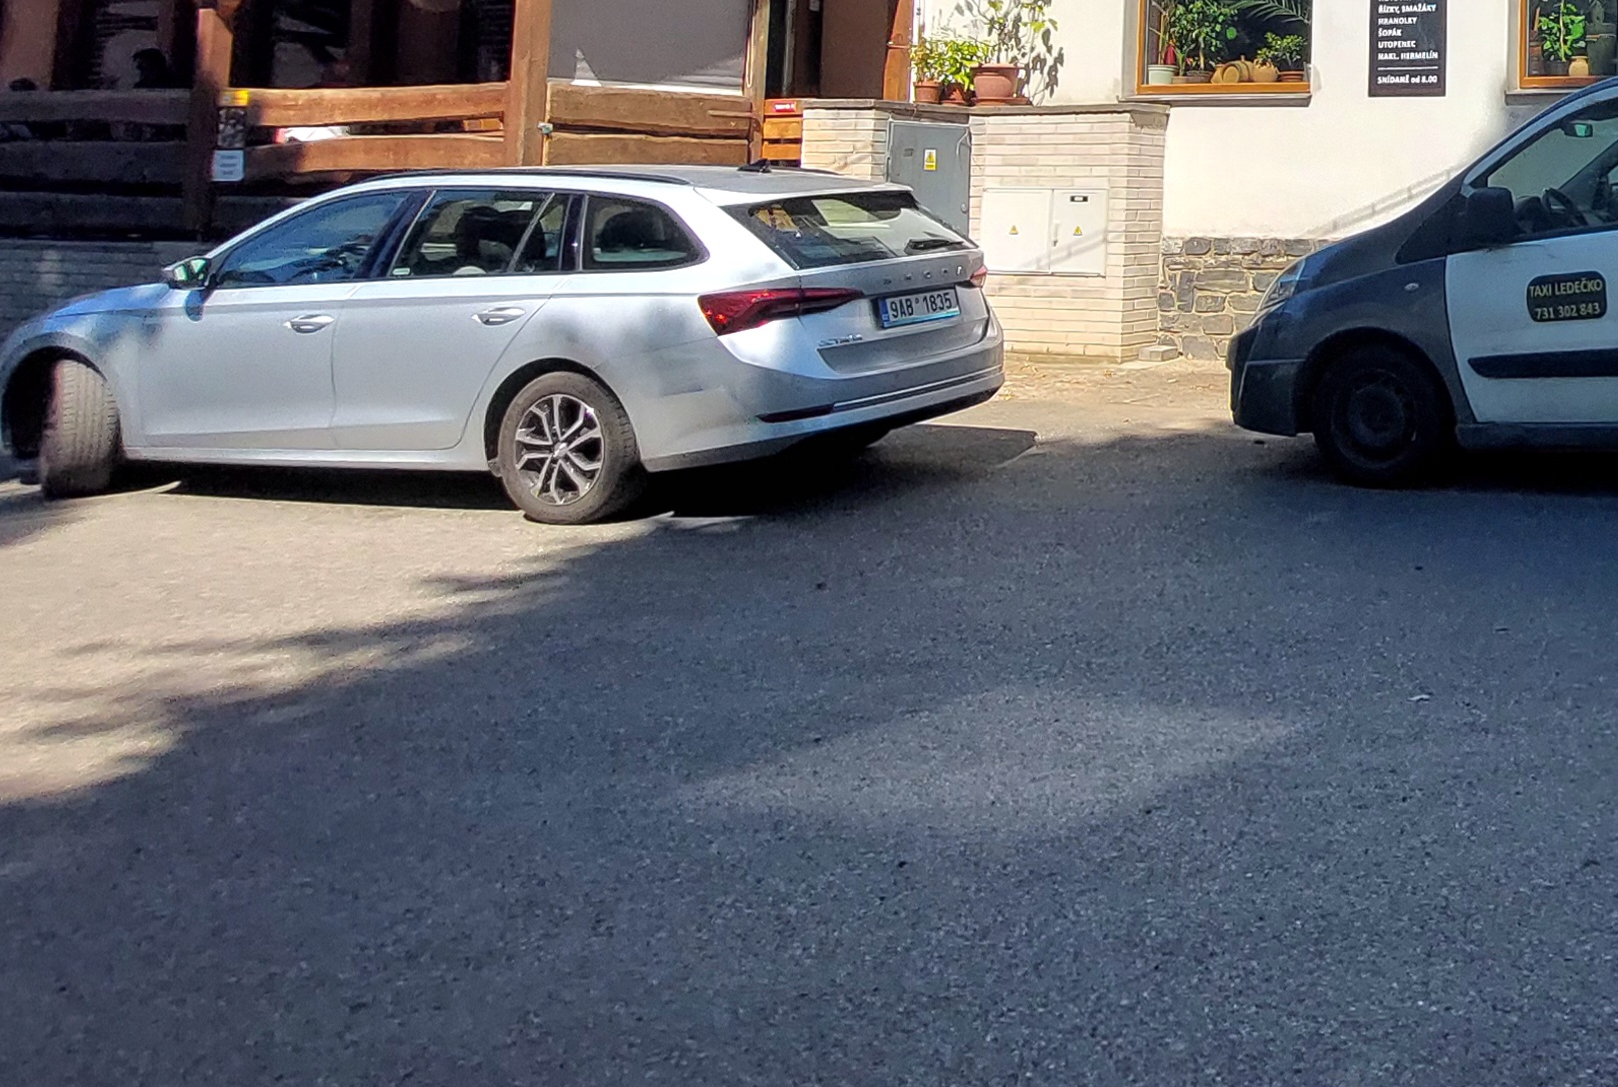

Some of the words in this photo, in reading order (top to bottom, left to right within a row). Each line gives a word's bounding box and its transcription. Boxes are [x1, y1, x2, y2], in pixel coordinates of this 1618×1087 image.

[1378, 16, 1418, 26] HRANOLKY
[1377, 40, 1417, 49] UTOPENEC
[1400, 49, 1439, 60] HERMELÍN
[1377, 74, 1410, 85] SNÍDANĚ
[1529, 284, 1552, 298] TAXI
[1554, 277, 1603, 296] LEDEČKO
[890, 298, 914, 319] 9AB
[923, 292, 953, 314] 1835
[1534, 307, 1555, 320] 731
[1558, 304, 1577, 318] 302
[1580, 302, 1600, 315] 843
